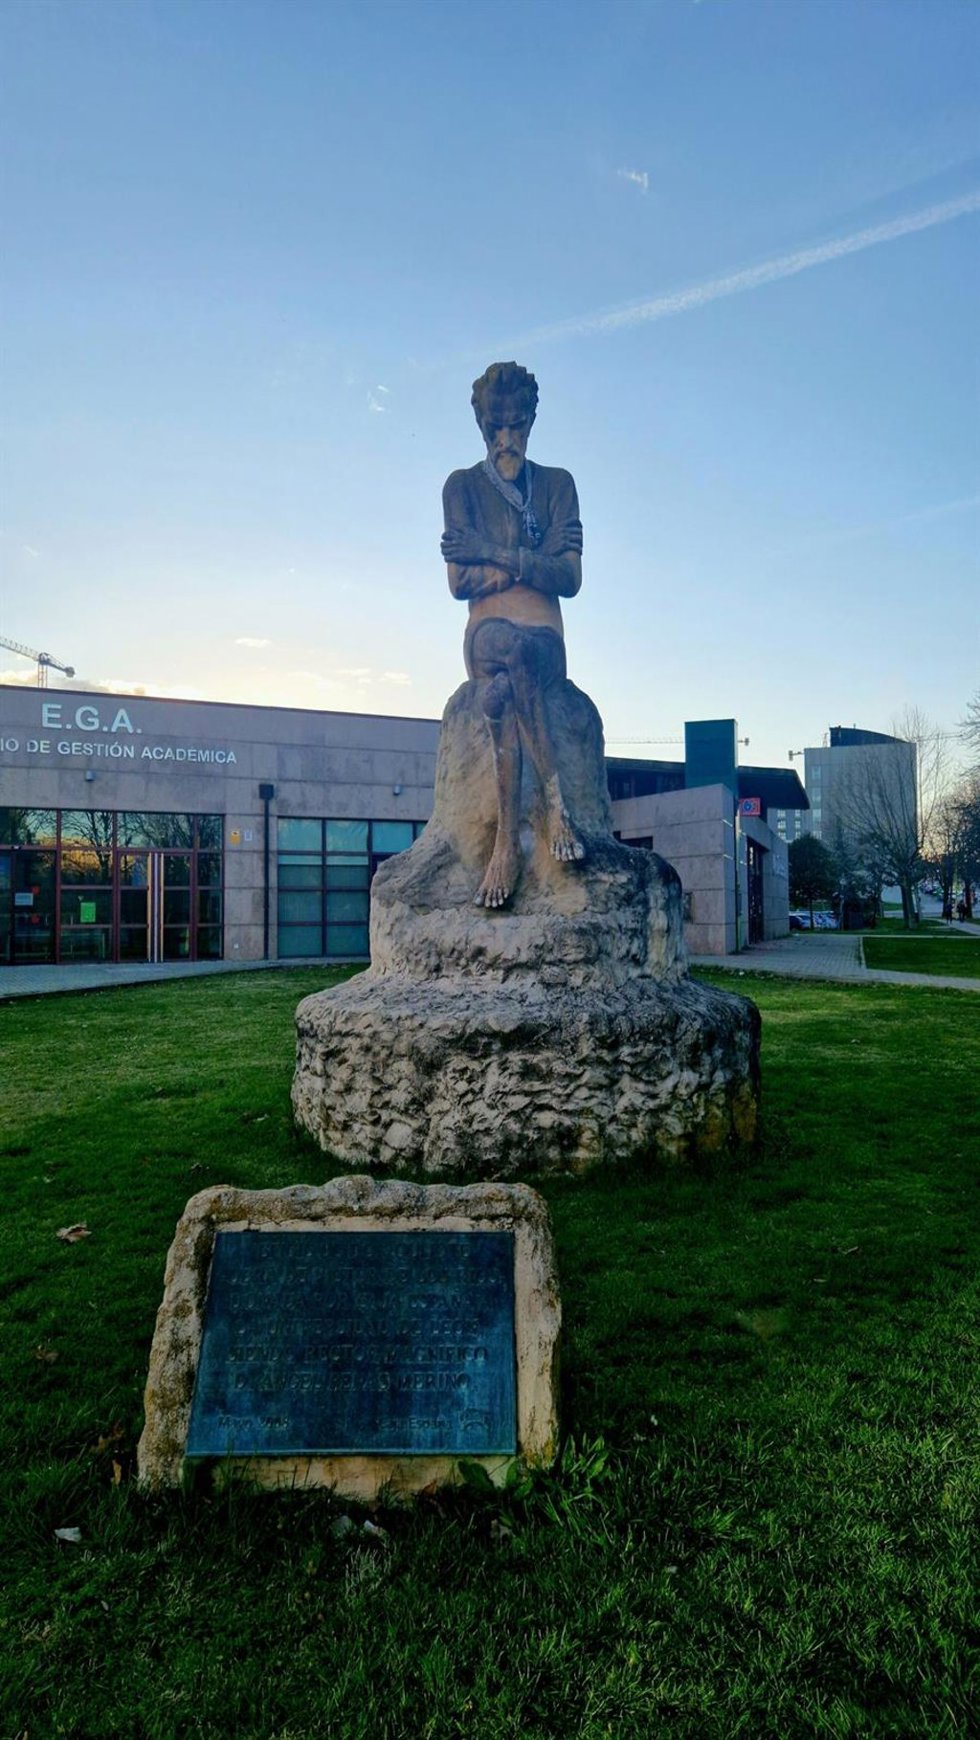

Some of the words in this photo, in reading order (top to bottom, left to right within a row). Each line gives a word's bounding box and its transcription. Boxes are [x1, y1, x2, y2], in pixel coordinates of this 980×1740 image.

[42, 703, 142, 734] E.G.A.
[27, 740, 51, 754] DE
[57, 741, 135, 759] GESTIÓN
